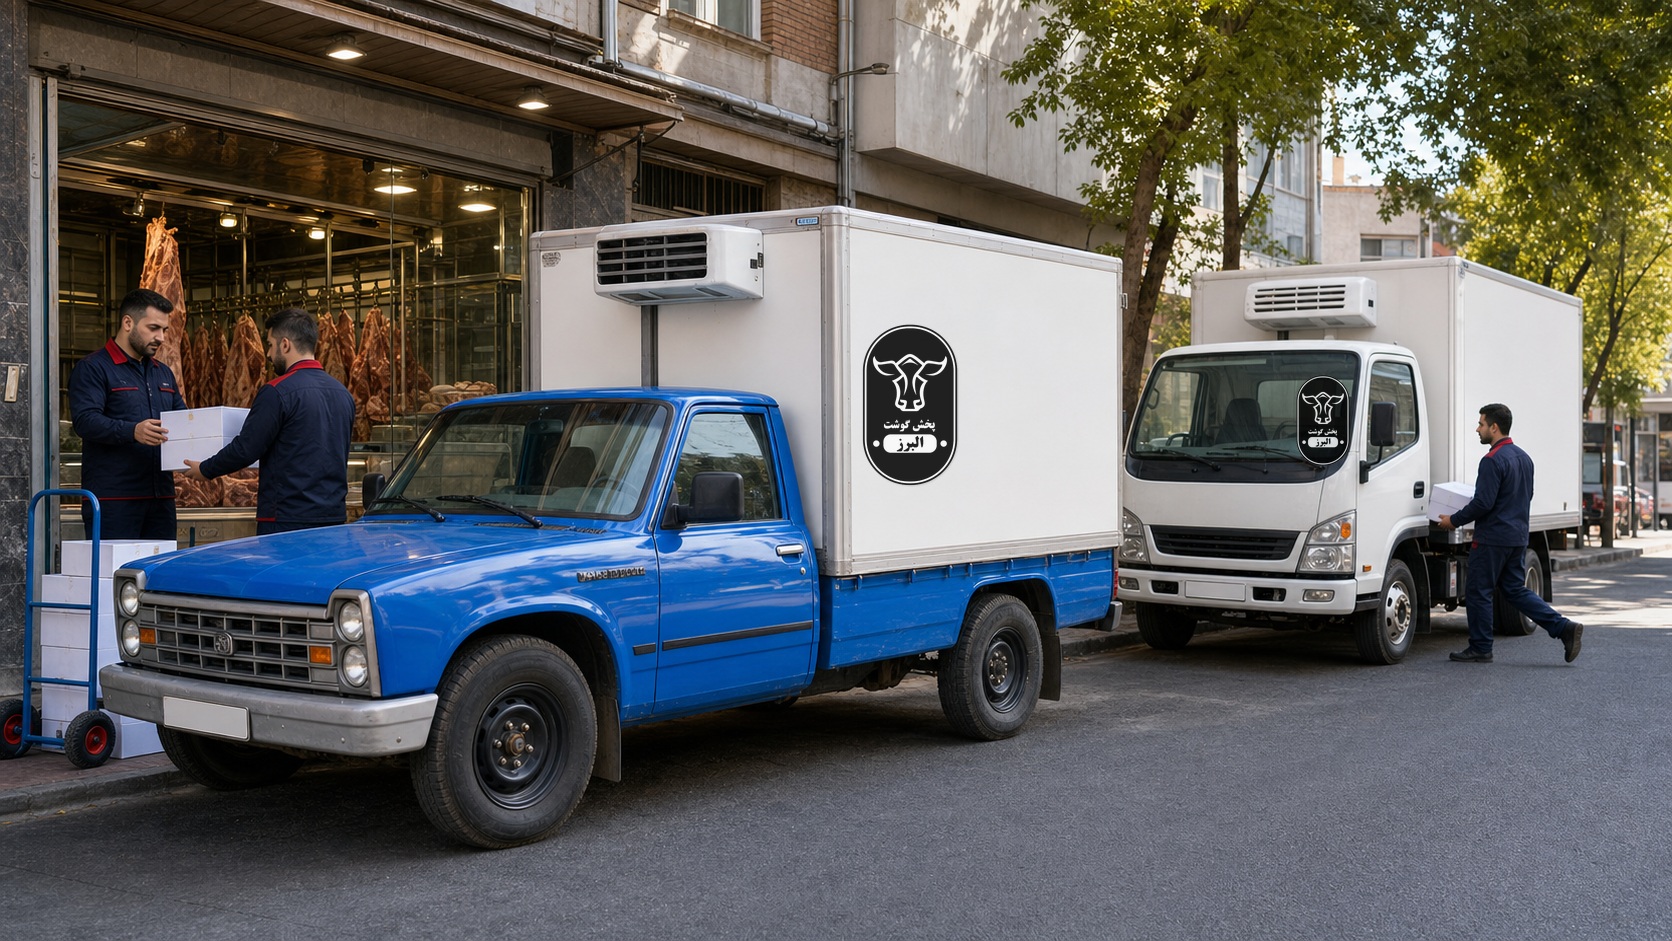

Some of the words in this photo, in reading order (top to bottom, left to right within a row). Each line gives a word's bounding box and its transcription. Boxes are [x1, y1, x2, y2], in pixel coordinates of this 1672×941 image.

[883, 419, 911, 432] گوشت
[912, 419, 936, 432] پخش
[1324, 428, 1338, 436] پخش
[896, 435, 924, 452] البرز
[1315, 438, 1331, 447] البرز
